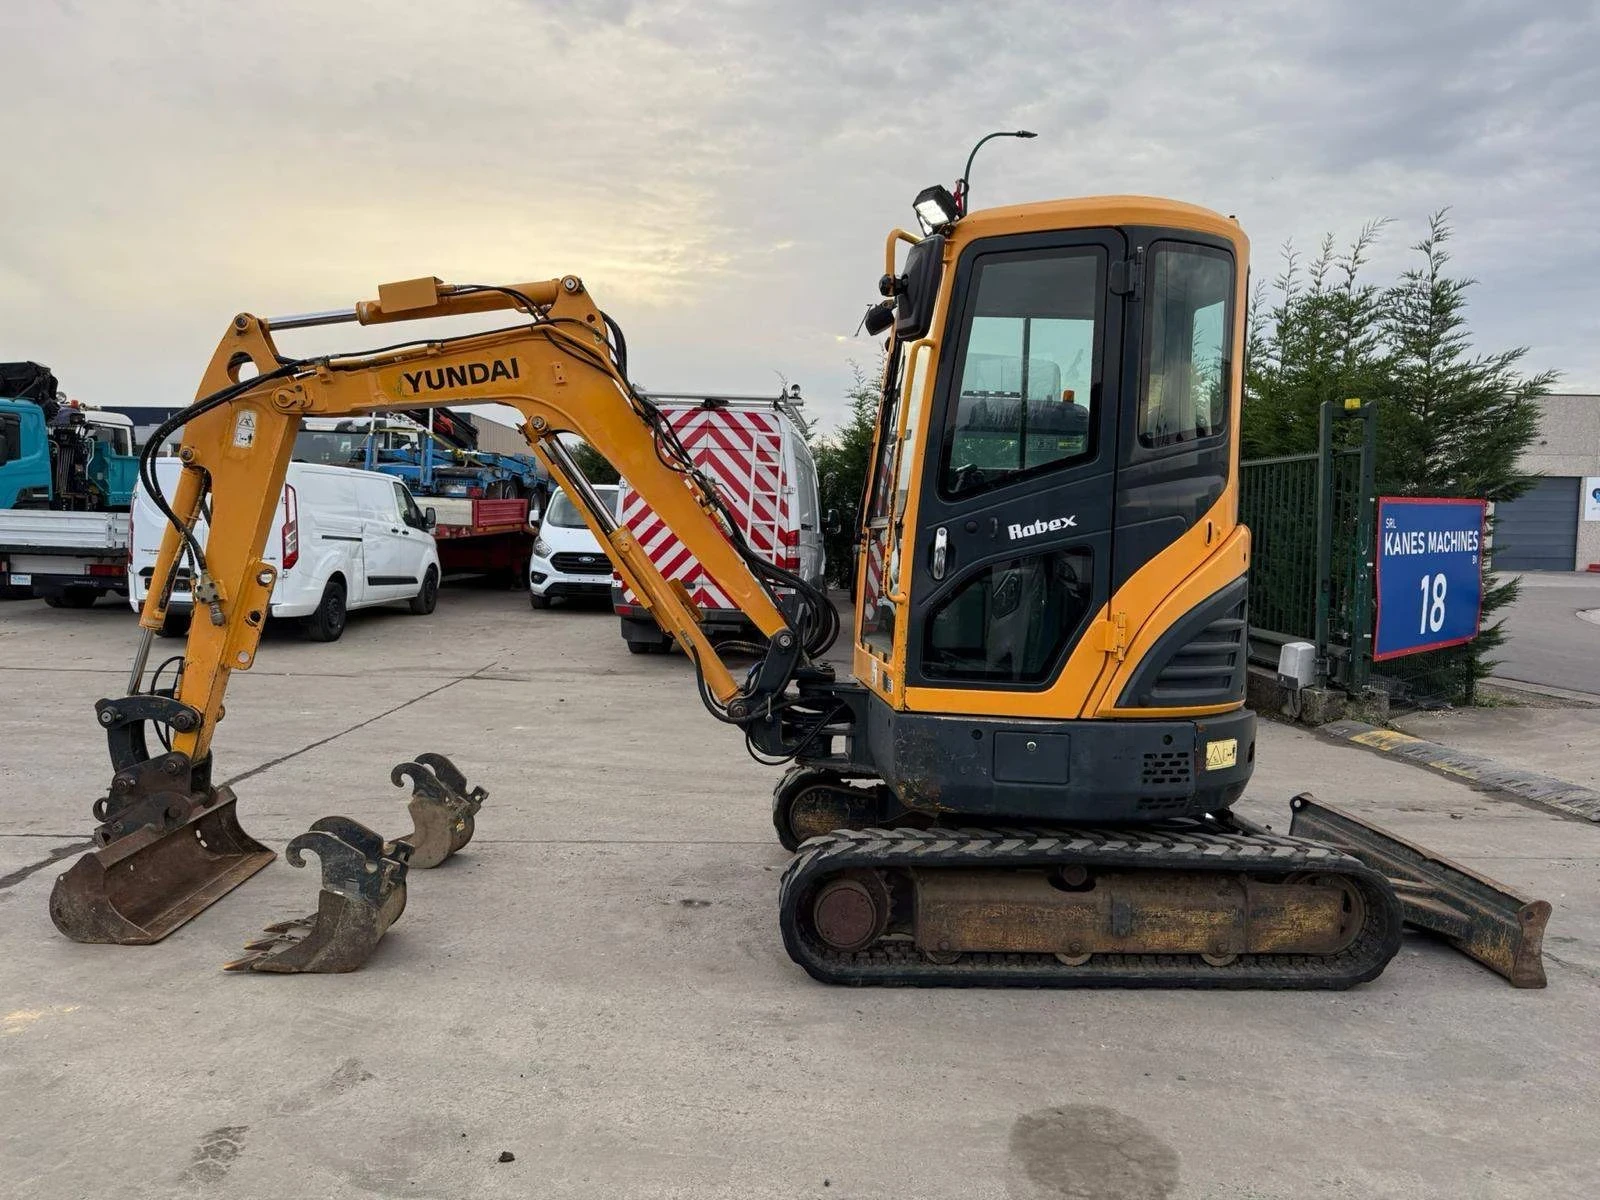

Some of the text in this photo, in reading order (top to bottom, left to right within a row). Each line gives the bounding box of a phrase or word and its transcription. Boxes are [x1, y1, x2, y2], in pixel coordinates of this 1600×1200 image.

[403, 358, 520, 393] YUNDAI
[1007, 515, 1077, 540] Robex
[1385, 530, 1479, 555] KANES MACHINES
[1420, 573, 1447, 634] 18
